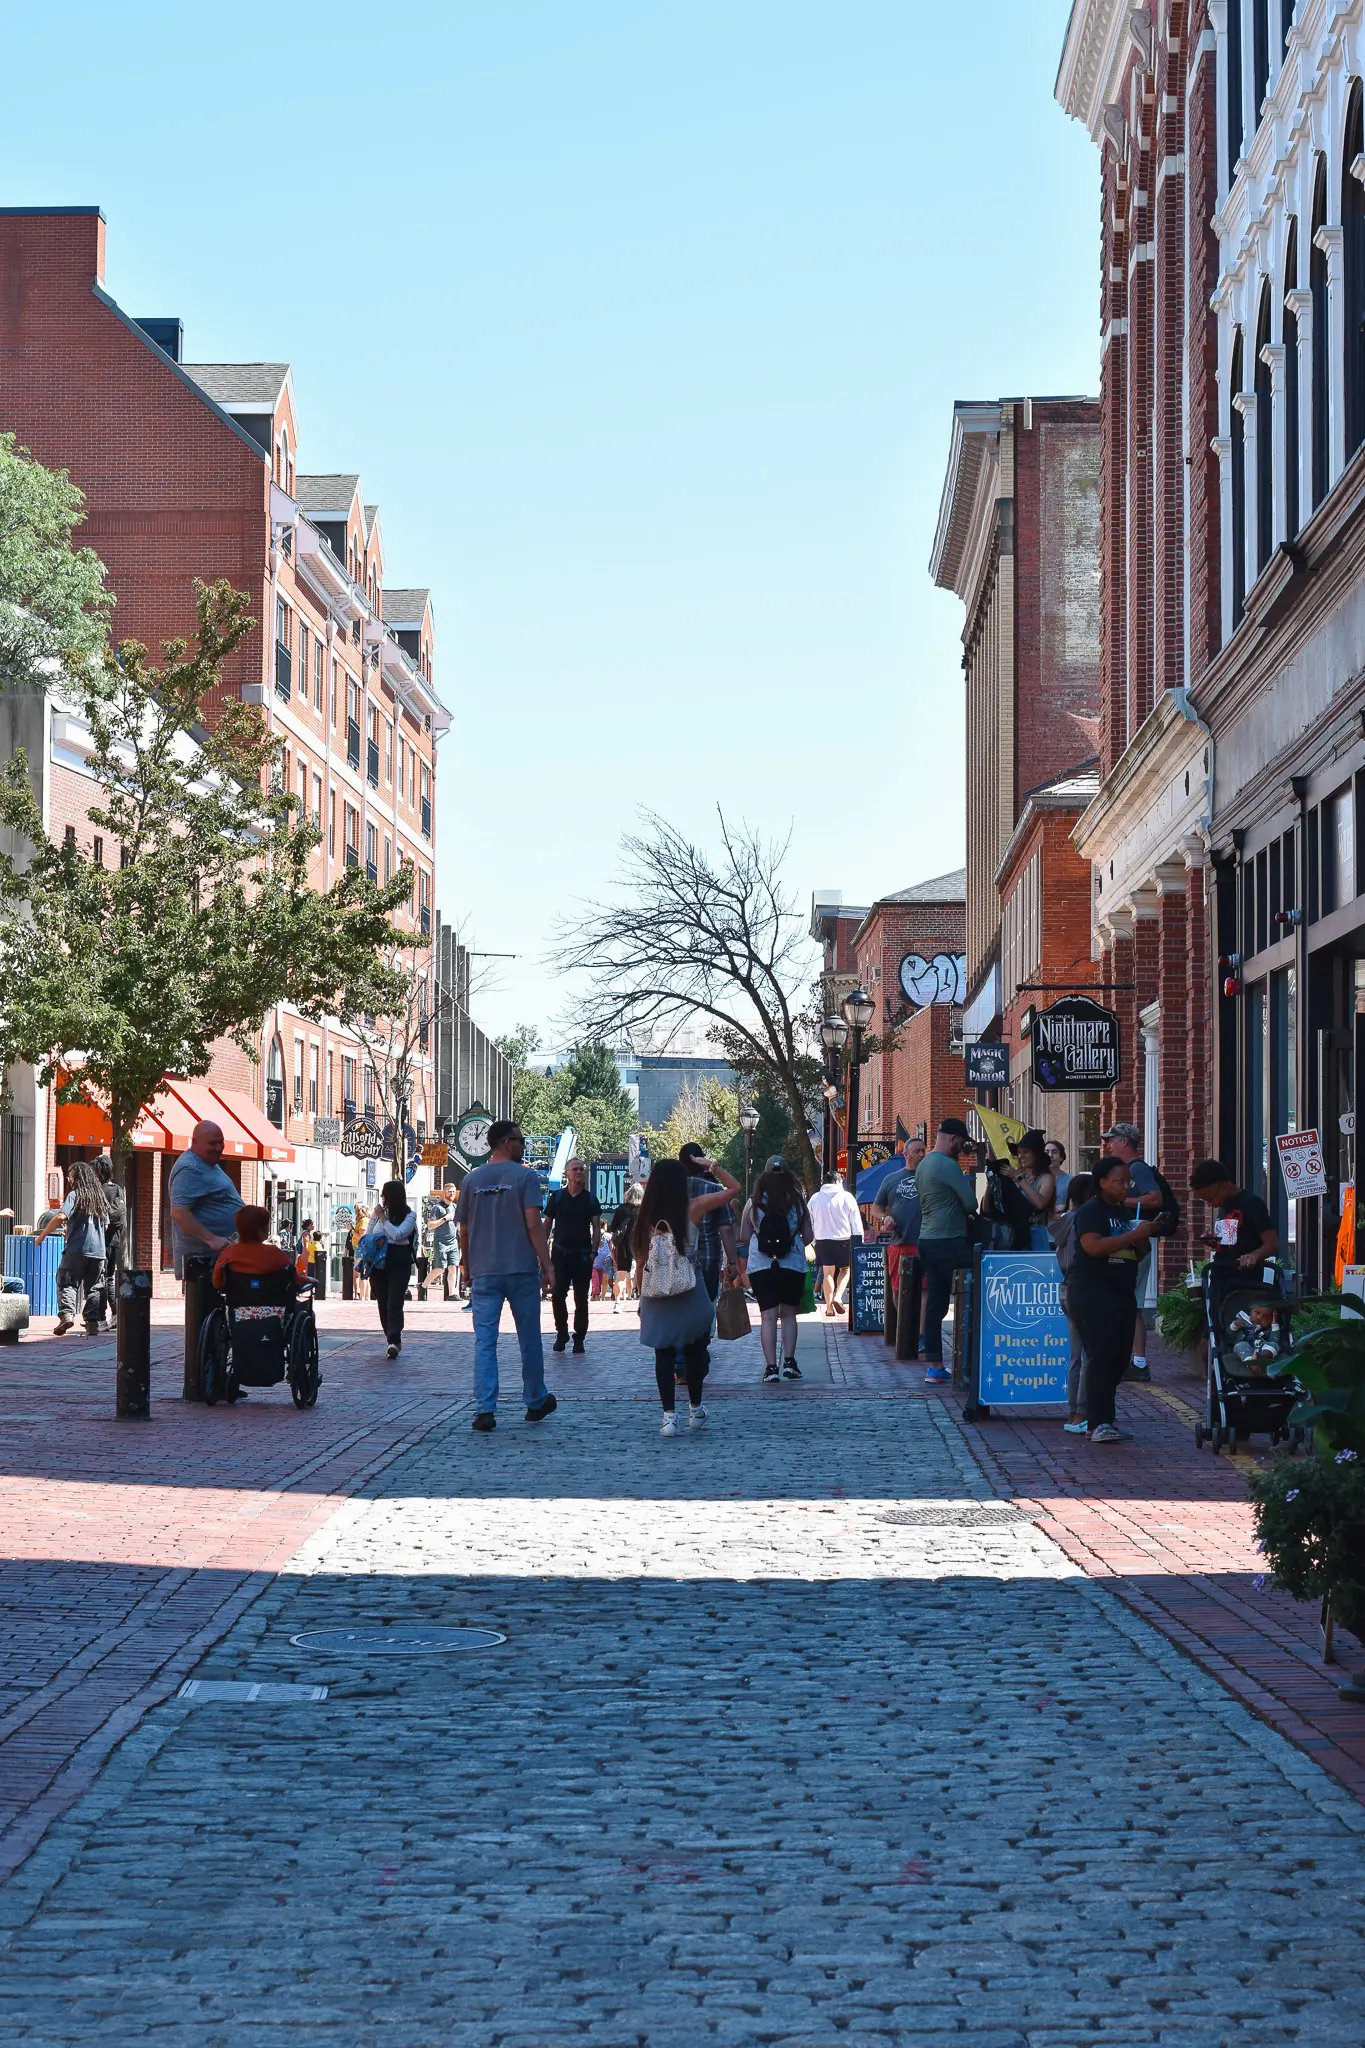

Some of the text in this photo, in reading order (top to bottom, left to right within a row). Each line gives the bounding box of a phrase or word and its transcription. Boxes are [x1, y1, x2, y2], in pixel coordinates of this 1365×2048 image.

[1036, 1017, 1110, 1053] Nightmare
[970, 1047, 1005, 1063] MAGIC
[1064, 1043, 1115, 1078] Gallery
[969, 1069, 1005, 1082] PARLOR
[343, 1130, 377, 1145] World
[1281, 1134, 1314, 1147] NOTICE
[342, 1142, 381, 1157] Wizardry
[1299, 1186, 1327, 1195] LOITERING
[861, 1270, 876, 1278] THE
[985, 1276, 1061, 1313] TWILIGH
[1025, 1306, 1065, 1316] HOUS
[993, 1333, 1068, 1347] Place for
[995, 1353, 1066, 1367] Peculiar
[1002, 1372, 1058, 1389] People
